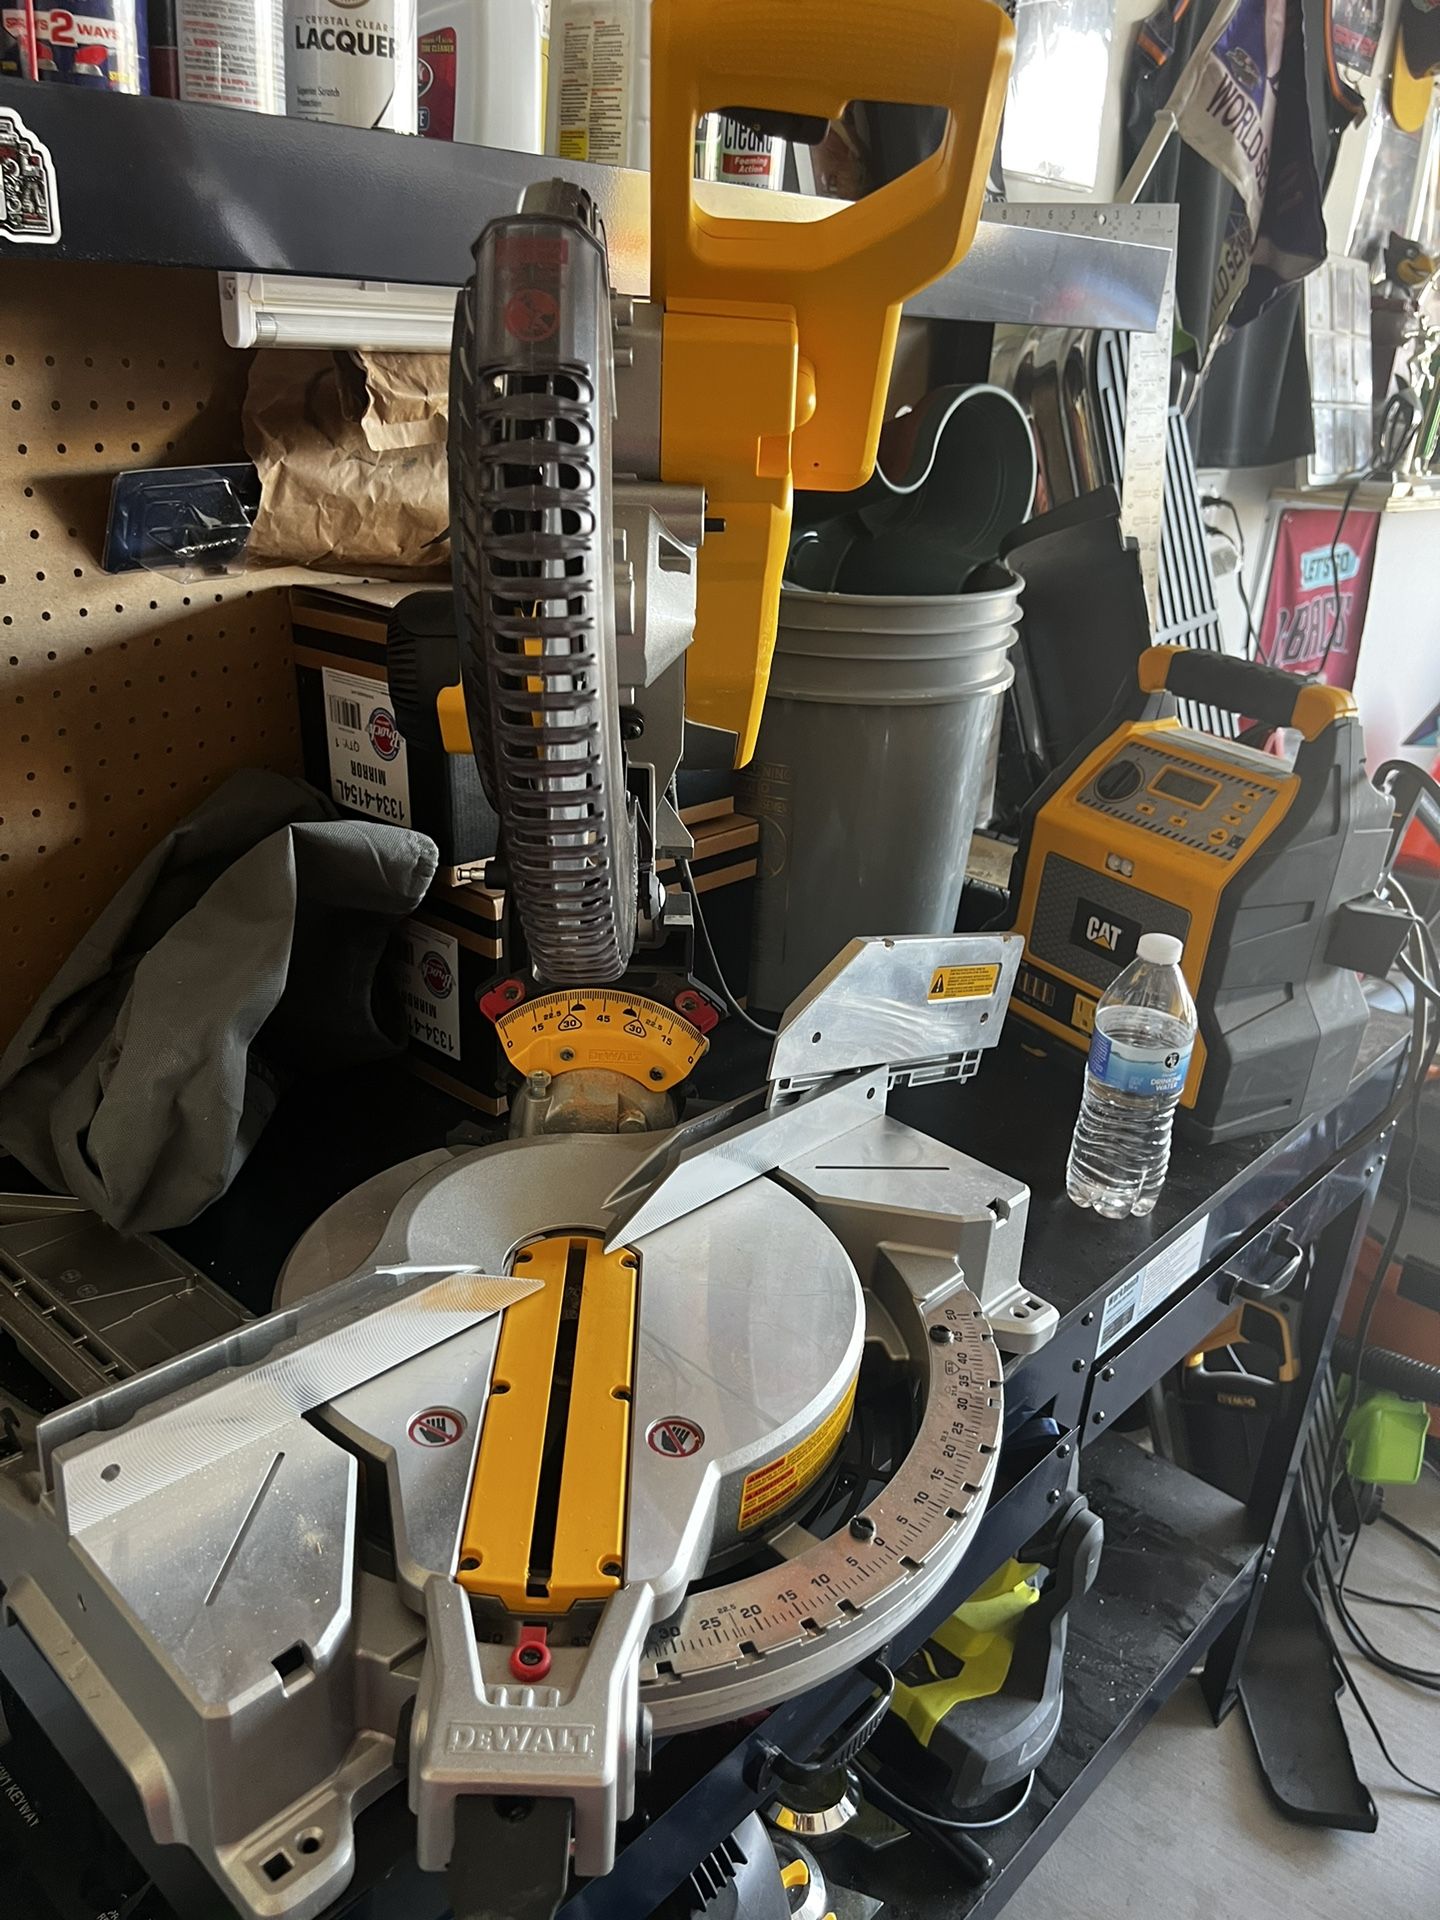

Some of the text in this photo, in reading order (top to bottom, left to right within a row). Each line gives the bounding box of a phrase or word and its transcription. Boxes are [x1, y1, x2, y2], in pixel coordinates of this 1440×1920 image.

[50, 9, 76, 44] 2
[76, 23, 119, 40] WAYS
[305, 16, 389, 32] CRYSTAL CLEAR
[734, 156, 769, 167] Foaming
[738, 165, 764, 174] Action
[335, 737, 340, 748] 1
[350, 759, 387, 787] MIRROR
[335, 779, 405, 821] 1334-4154L
[1086, 916, 1122, 951] CAT
[506, 1010, 694, 1065] 0 15 22.5 30 45 30 22.5 15 0
[658, 1309, 970, 1640] 50 45 40 35 30 25 20 15 10 5 0 5 10 15 20 25 30
[717, 1603, 737, 1614] 22.5
[449, 1724, 595, 1754] DEWALT
[5, 1783, 40, 1828] KEYWAY
